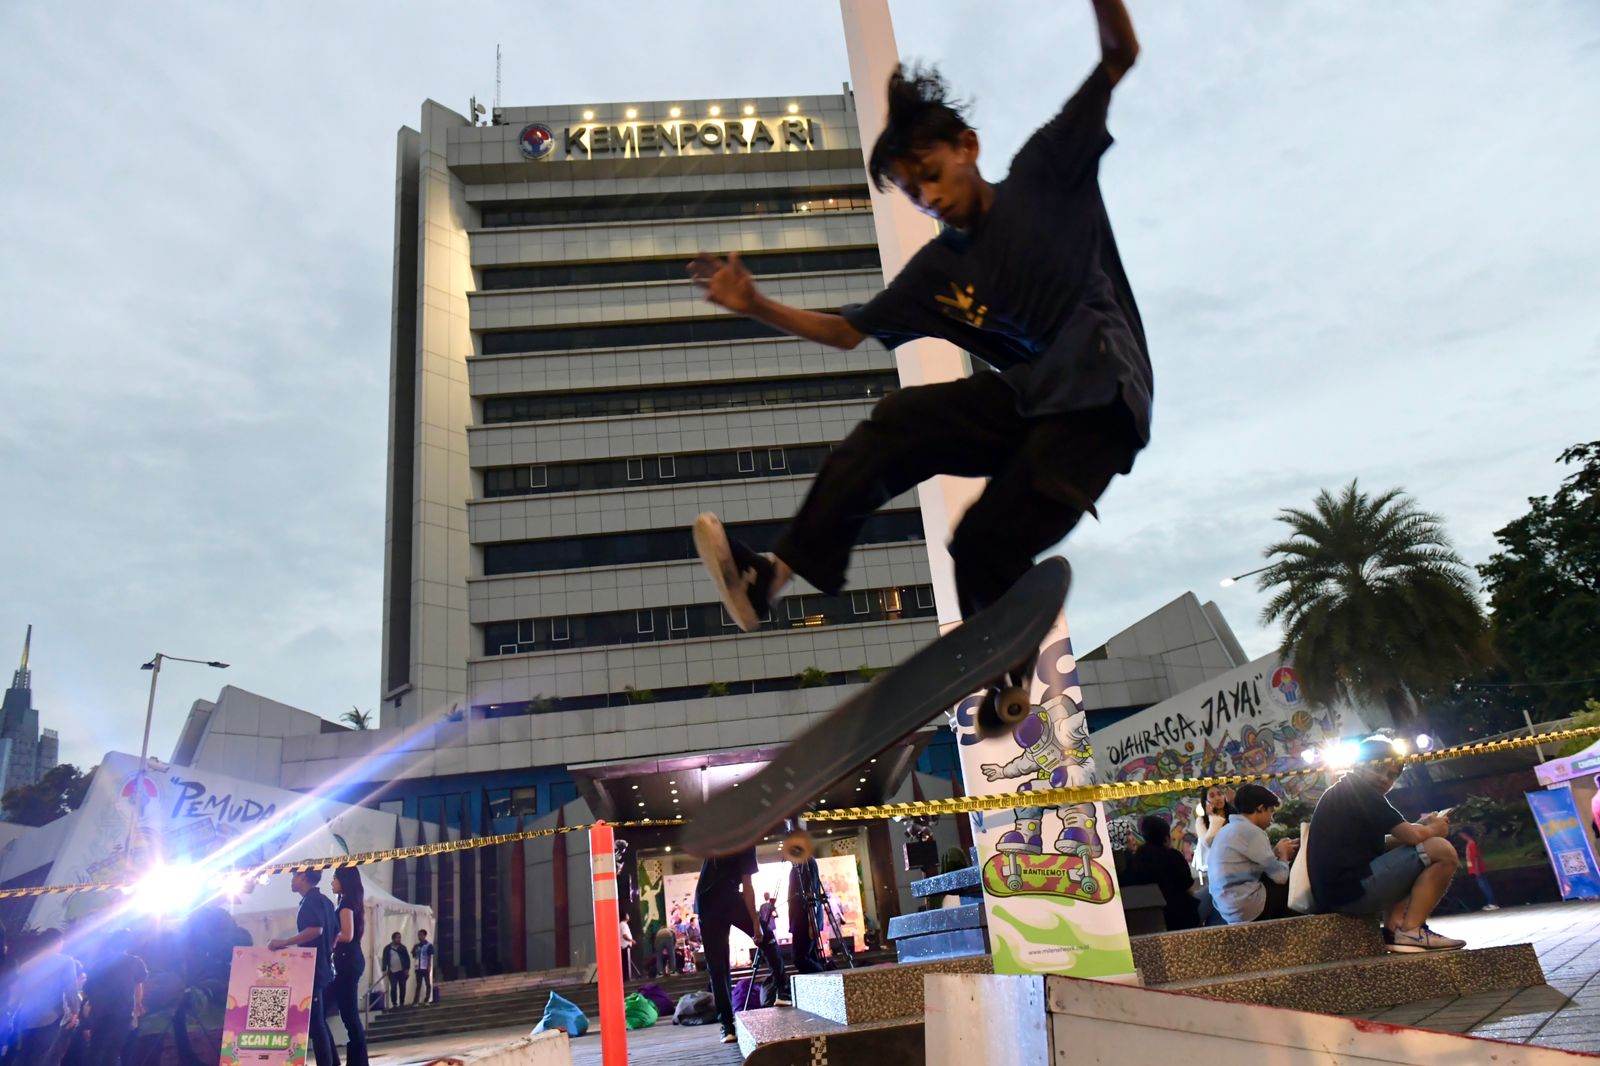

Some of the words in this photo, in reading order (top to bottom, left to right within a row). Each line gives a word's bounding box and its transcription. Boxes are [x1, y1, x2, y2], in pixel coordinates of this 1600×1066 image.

[564, 121, 774, 154] KEMENPORA
[781, 118, 815, 145] RI
[1023, 868, 1066, 877] #ANTILEMOT
[240, 1034, 269, 1046] SCAN
[271, 1035, 289, 1046] ME
